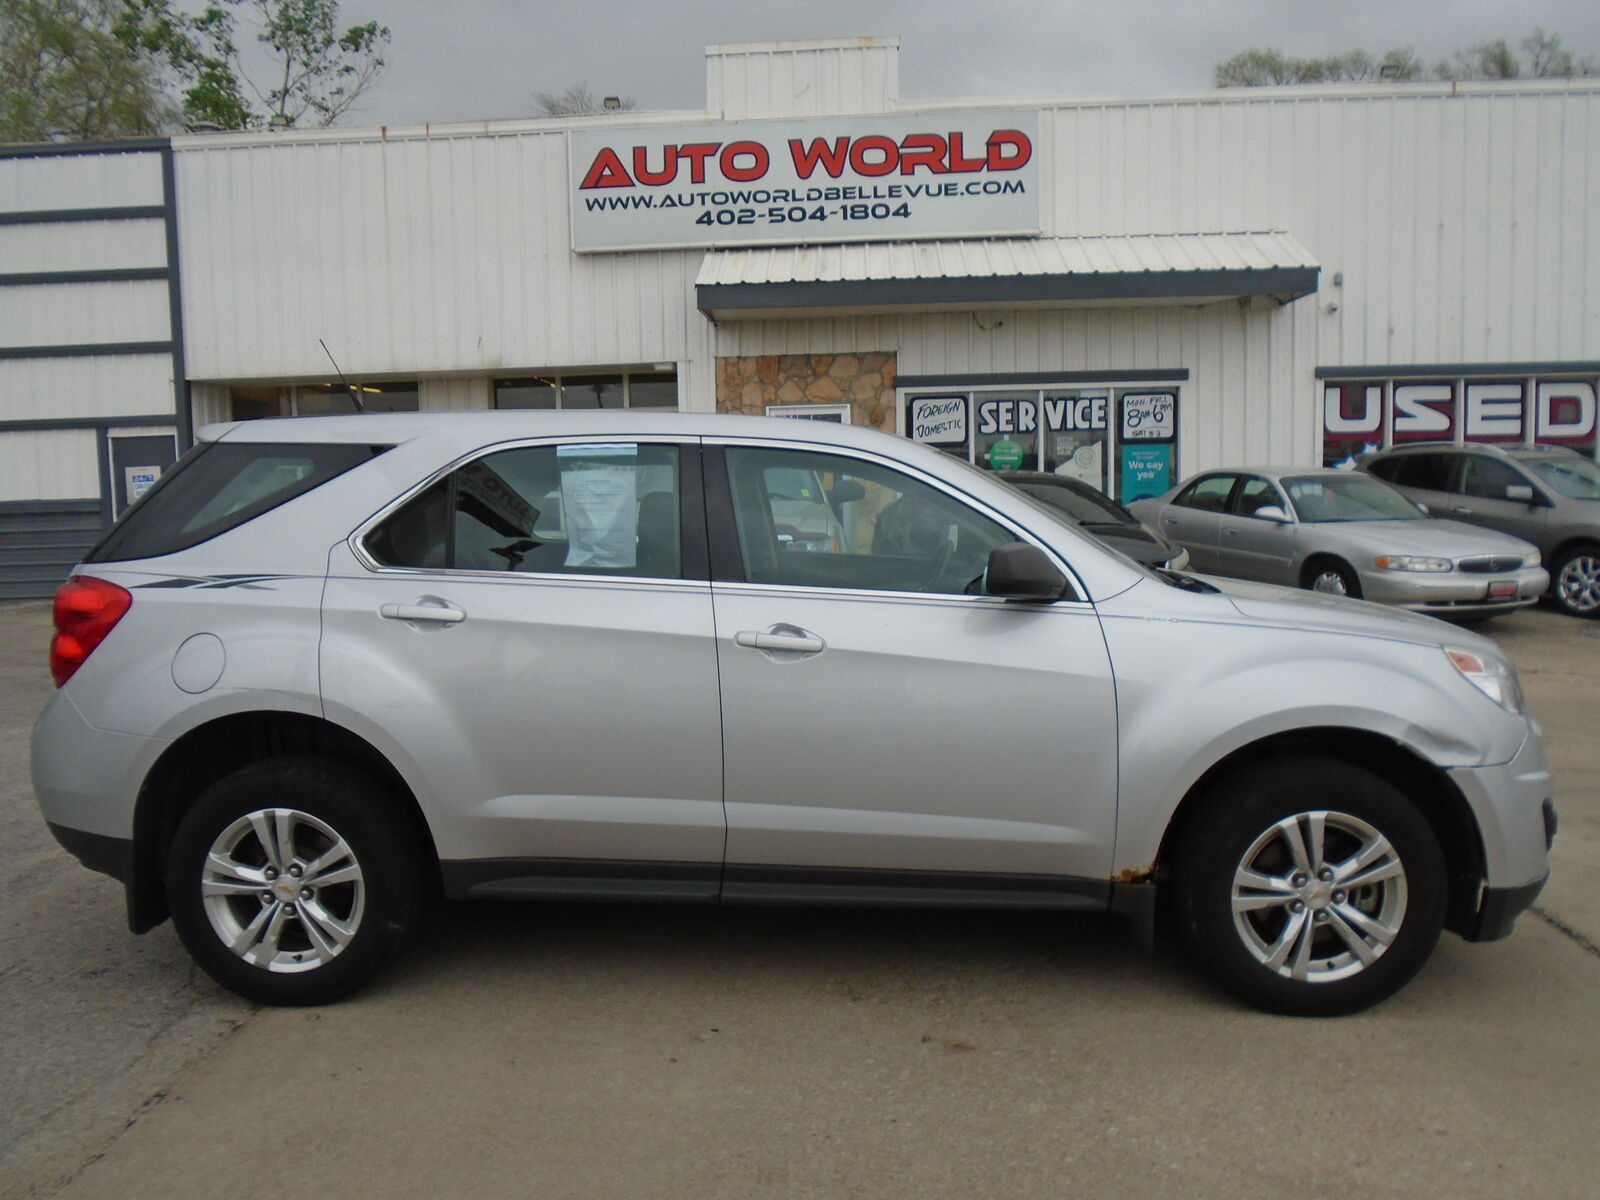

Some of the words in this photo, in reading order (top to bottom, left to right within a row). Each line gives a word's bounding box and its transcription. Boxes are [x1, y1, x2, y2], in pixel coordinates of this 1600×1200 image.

[578, 140, 770, 189] AUTO
[787, 129, 1033, 180] WORLD
[585, 179, 1026, 212] WWW.AUTOWORLDBELLEVUE.COM
[695, 202, 912, 226] 402-504-1804
[916, 400, 961, 420] FOREIGN
[978, 396, 1108, 435] SERVICE
[1324, 382, 1597, 438] USED
[916, 419, 962, 438] DOMESTIC
[1128, 460, 1144, 469] We
